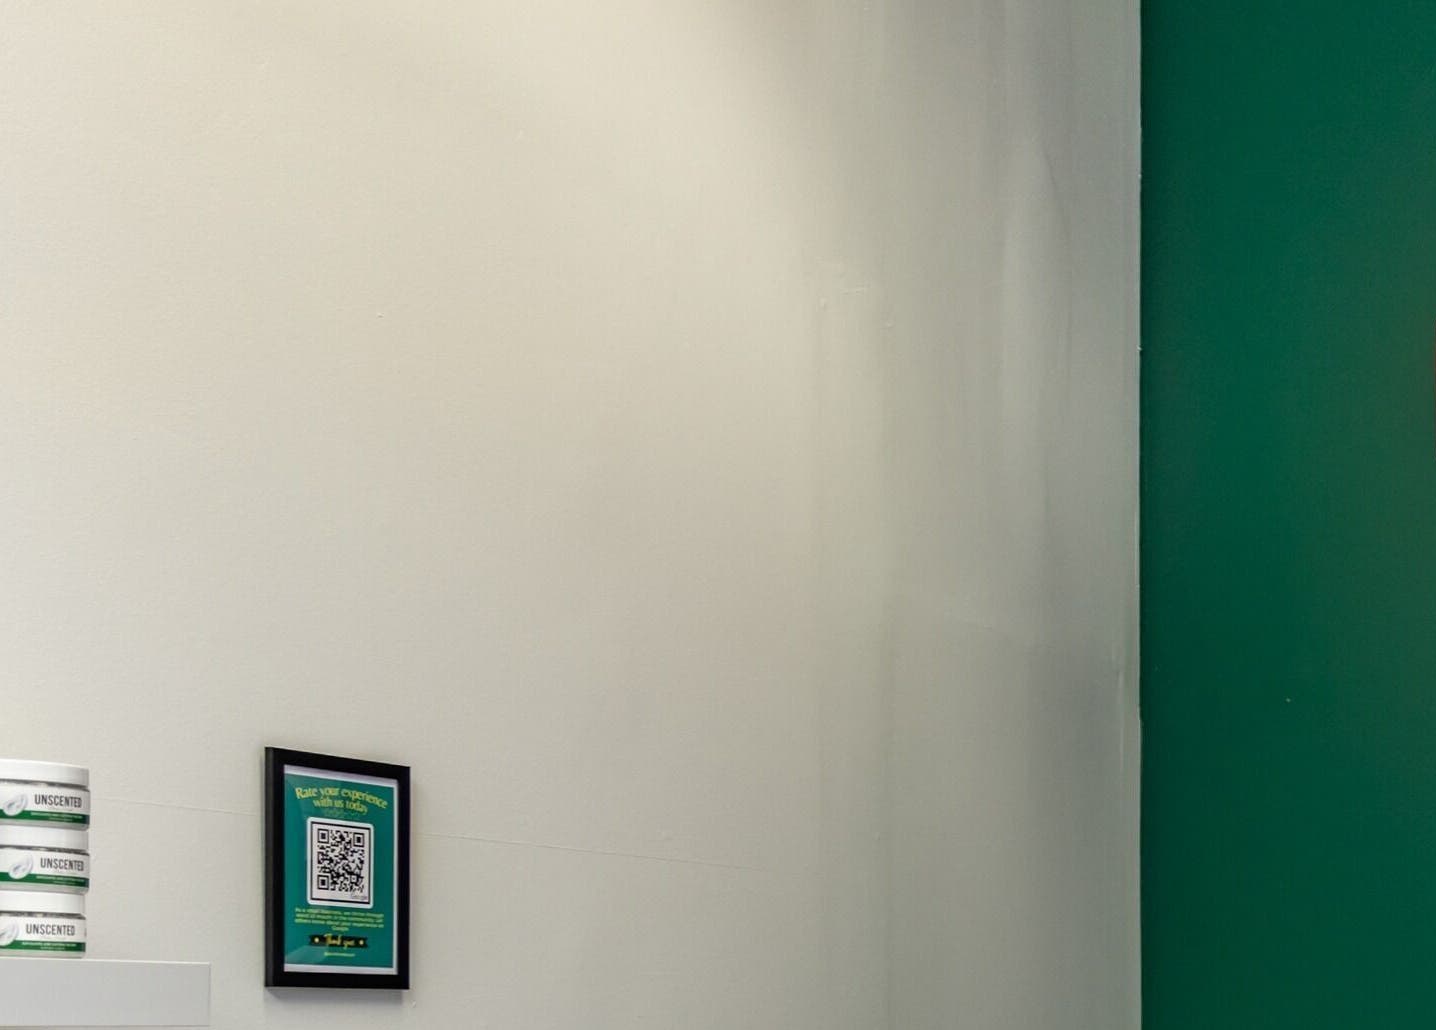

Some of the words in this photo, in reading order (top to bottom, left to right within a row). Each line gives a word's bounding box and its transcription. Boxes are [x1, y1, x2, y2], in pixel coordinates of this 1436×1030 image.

[34, 794, 82, 808] UNSCENTED
[295, 787, 318, 799] Rate
[319, 787, 340, 799] your
[341, 788, 388, 809] experience
[40, 857, 84, 871] UNSCENTED
[26, 923, 76, 936] UNSCENTED
